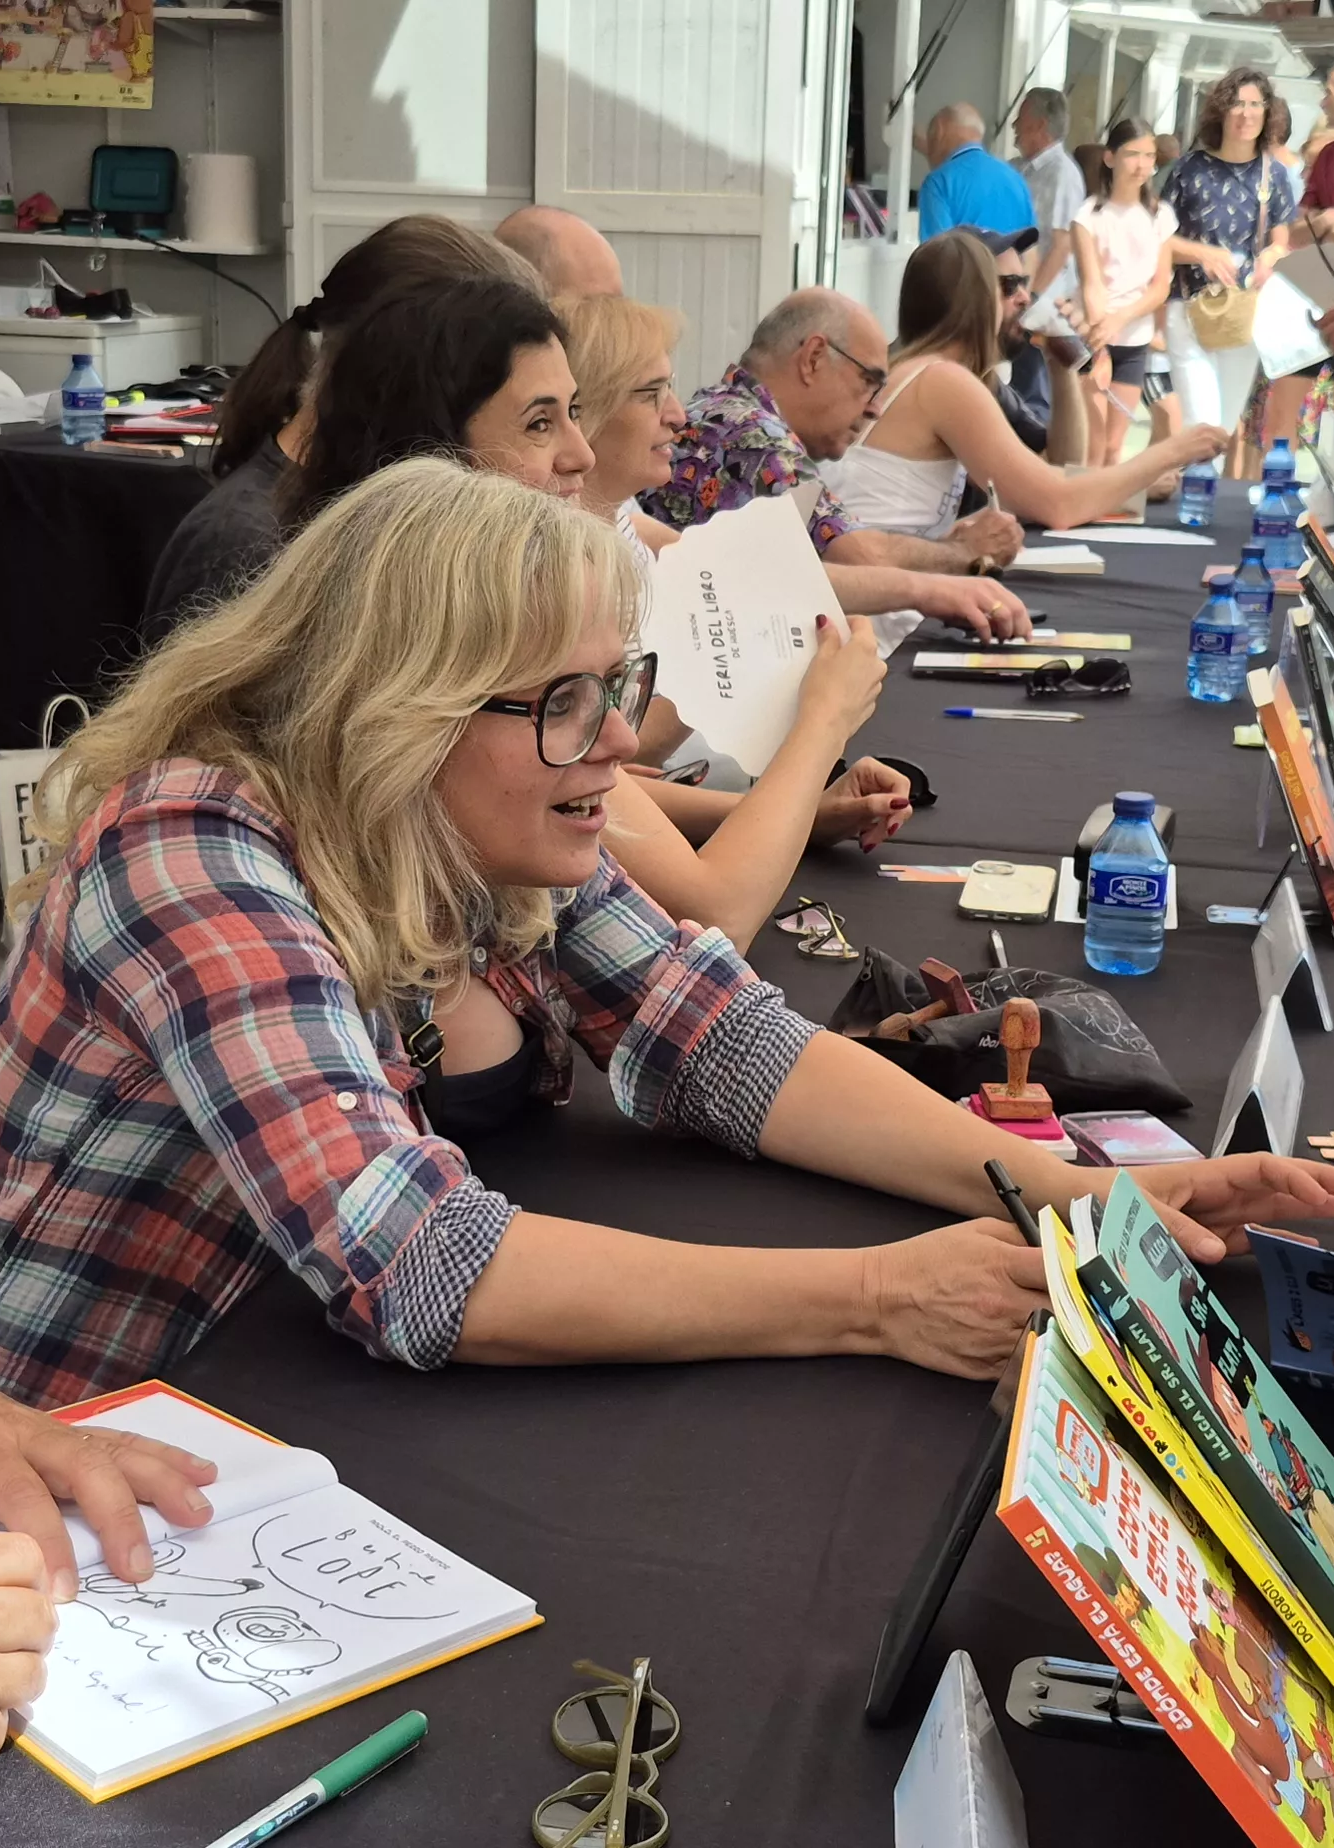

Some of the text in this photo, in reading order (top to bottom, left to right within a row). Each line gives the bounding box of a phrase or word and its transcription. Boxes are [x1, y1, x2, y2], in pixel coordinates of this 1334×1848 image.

[699, 570, 734, 700] FERIA DEL LIBRO
[724, 610, 740, 659] DE HUESCA
[1128, 1322, 1162, 1363] FLAT!
[1190, 1295, 1208, 1328] SR.
[1160, 1363, 1180, 1389] SR.
[1218, 1337, 1242, 1383] FLAT!
[1178, 1389, 1197, 1411] EL
[1113, 1466, 1141, 1559] ¿DÓNDE
[281, 1536, 407, 1600] LOPE
[1142, 1507, 1169, 1596] ESTÁ EL
[1176, 1545, 1198, 1618] AGUA?
[1043, 1550, 1193, 1731] ¿DÓNDE ESTÁ EL AGUA?
[1259, 1579, 1315, 1645] DOS ROBOTS
